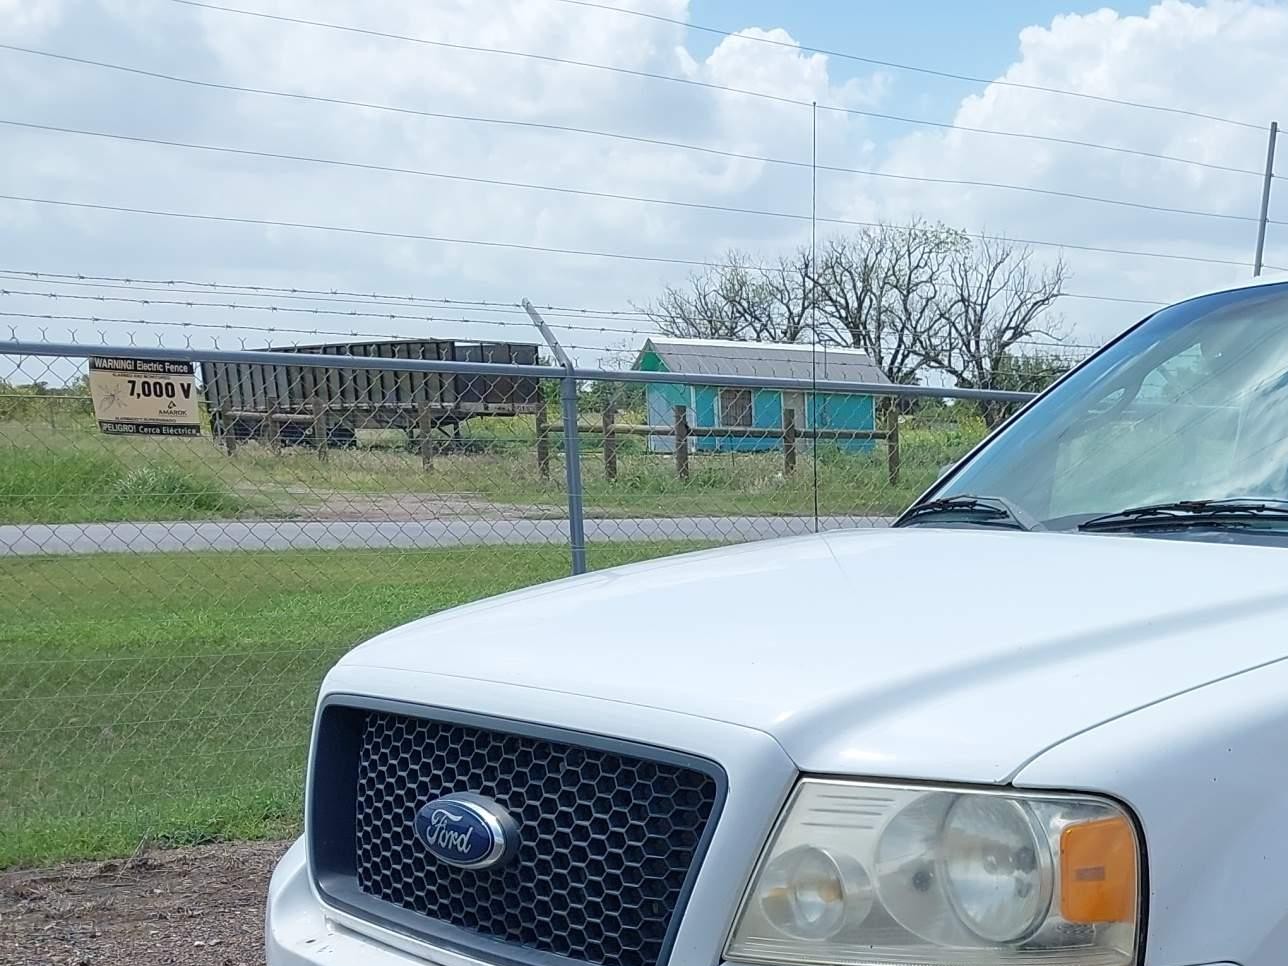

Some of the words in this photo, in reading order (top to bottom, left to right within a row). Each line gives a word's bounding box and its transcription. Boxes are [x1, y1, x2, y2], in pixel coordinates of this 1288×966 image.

[94, 357, 135, 371] WARNING!
[136, 359, 164, 373] Electric
[164, 361, 189, 374] Fence
[128, 380, 176, 399] 7,000
[180, 382, 192, 399] V
[103, 423, 137, 433] PELIGRO!
[138, 425, 161, 435] Cerca
[426, 808, 474, 854] Ford
